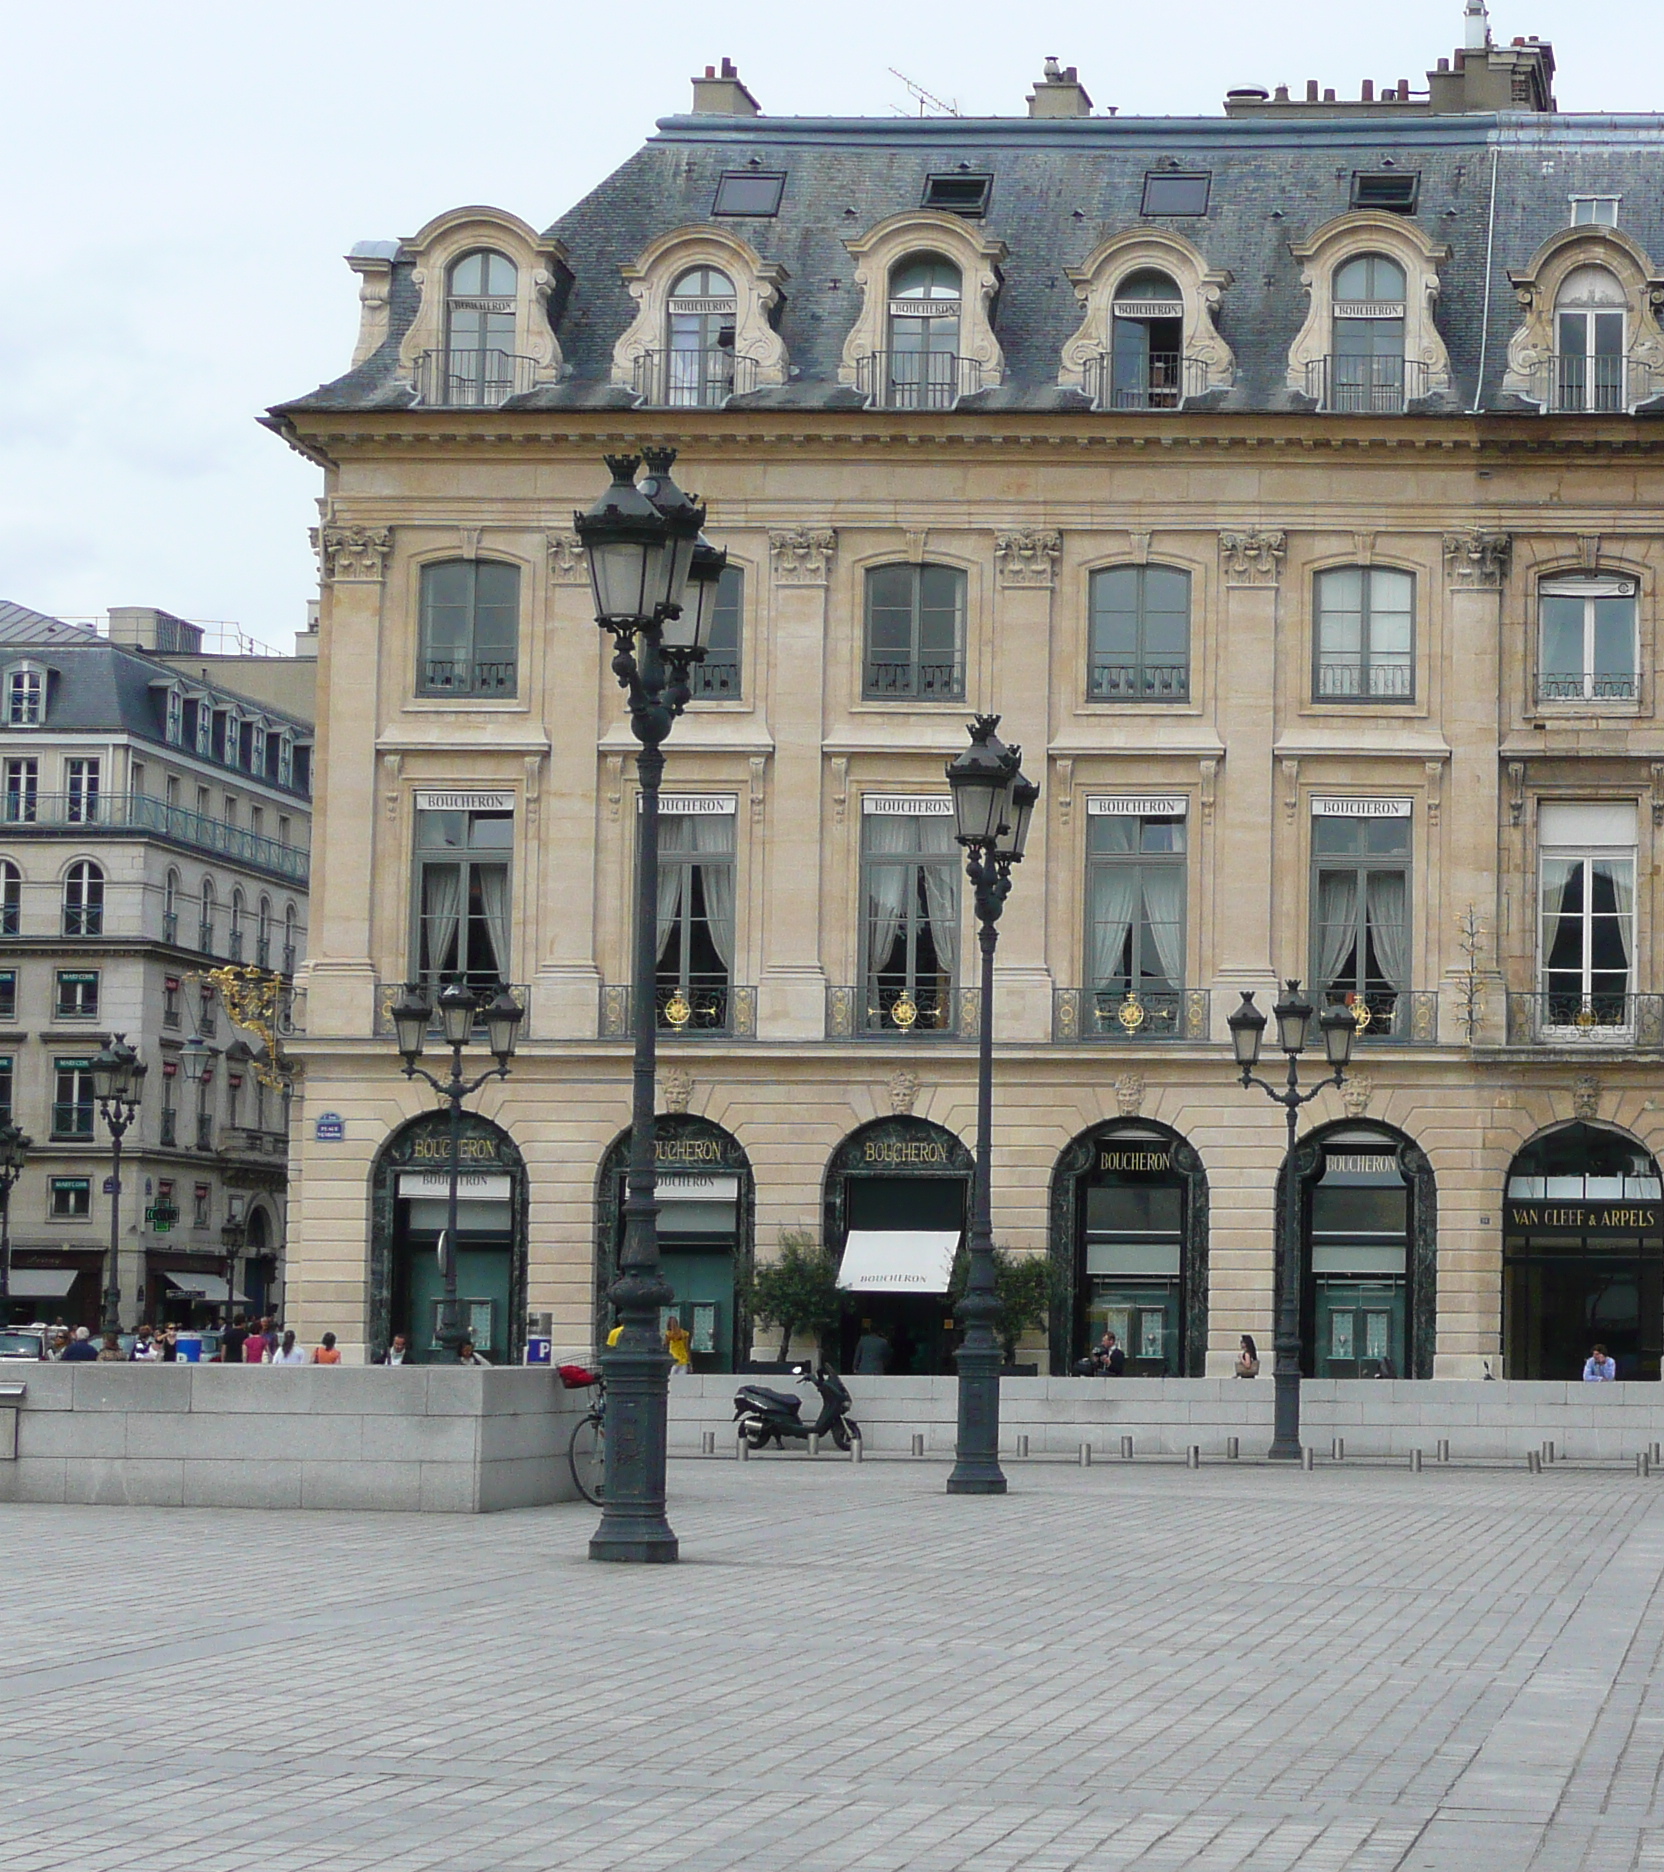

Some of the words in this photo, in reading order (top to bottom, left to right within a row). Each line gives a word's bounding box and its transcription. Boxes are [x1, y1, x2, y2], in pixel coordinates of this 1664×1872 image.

[428, 795, 503, 809] BOUCHERON
[657, 799, 724, 812] OUCHERON
[875, 800, 951, 813] BOUCHERON
[1099, 801, 1175, 813] BOUCHERON
[1323, 802, 1399, 814] BOUCHERON
[414, 1139, 495, 1158] BOUCERON
[654, 1140, 721, 1160] UCHERON
[865, 1142, 948, 1162] BOUCHERON
[1101, 1152, 1170, 1171] BOUCHERON
[1326, 1154, 1395, 1172] BOUCHERON
[423, 1173, 488, 1187] BOUCERON
[656, 1176, 714, 1188] OUCHERON
[1512, 1208, 1539, 1226] VAN
[1544, 1209, 1585, 1226] CLEEF
[1588, 1214, 1597, 1226] &
[1601, 1210, 1655, 1227] ARPELS
[539, 1341, 550, 1358] P
